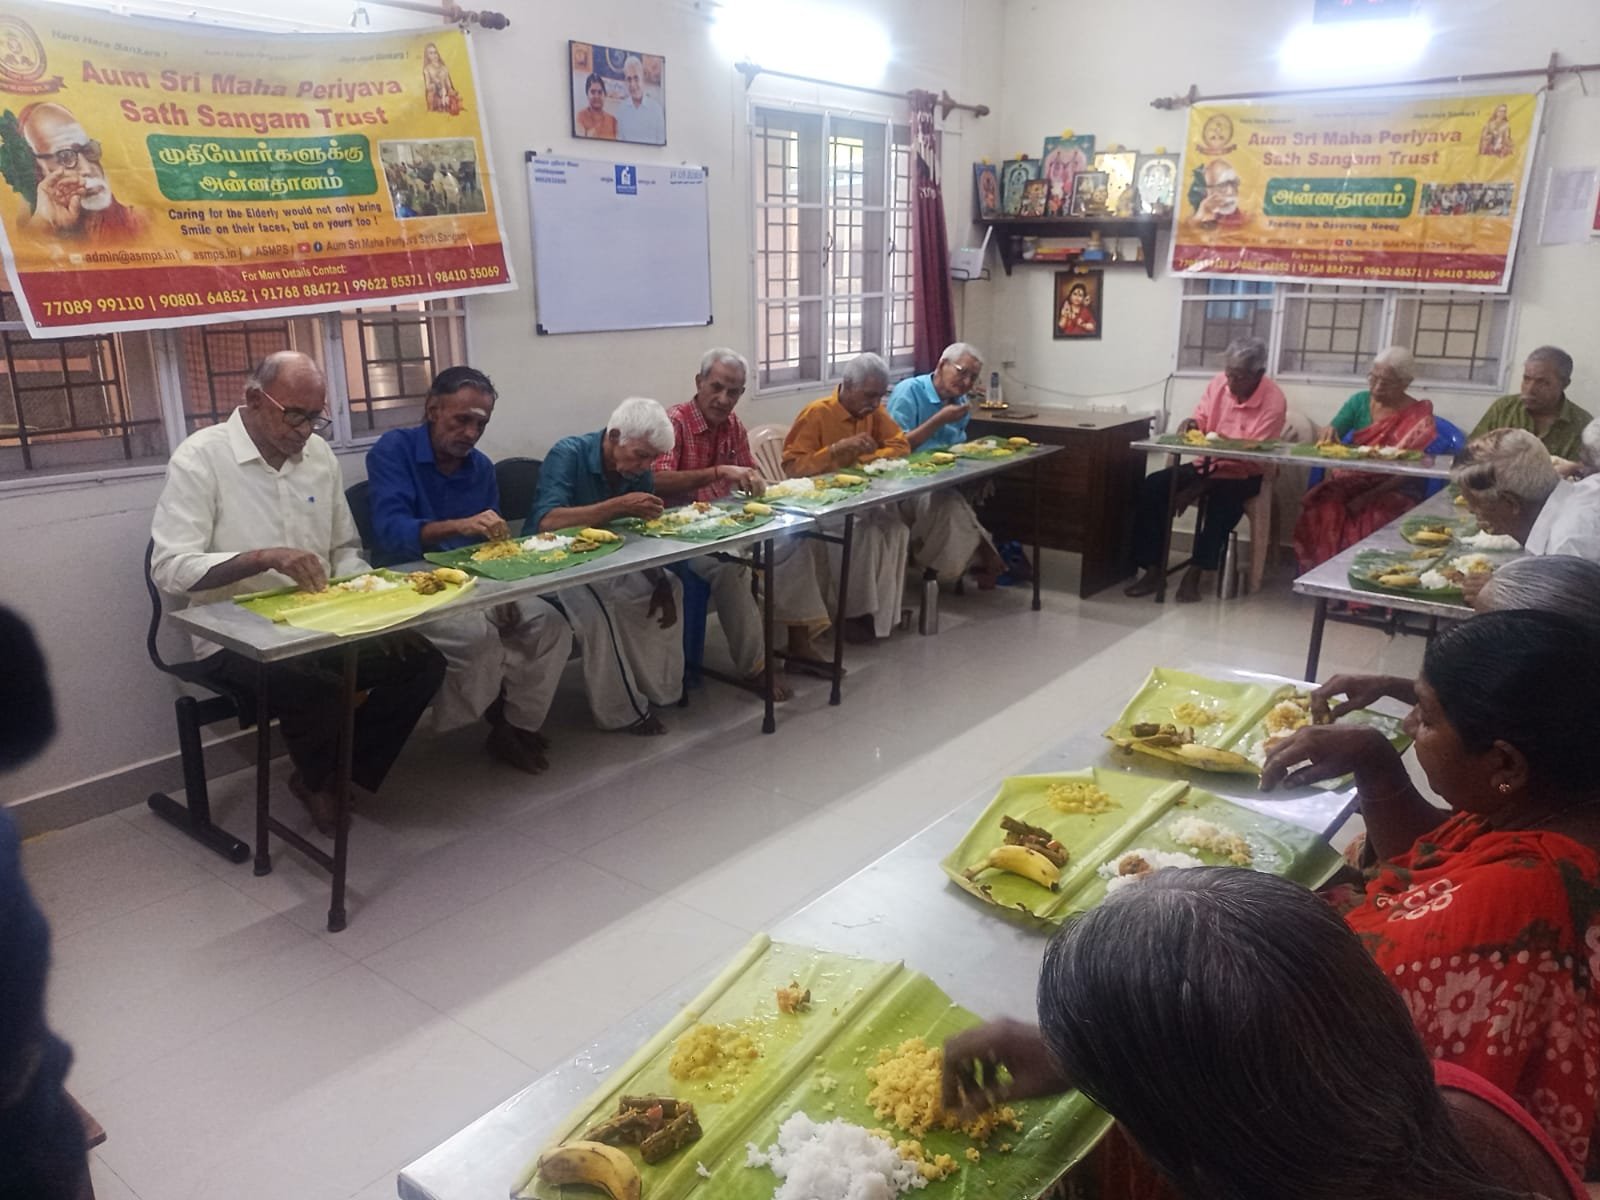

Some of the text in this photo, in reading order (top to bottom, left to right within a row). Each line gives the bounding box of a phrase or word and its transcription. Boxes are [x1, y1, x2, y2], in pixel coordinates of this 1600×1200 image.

[82, 60, 402, 103] Aum Sri Maha Periyava
[120, 99, 388, 134] Sath Sangam Trust
[1248, 129, 1462, 146] Aum Sri Maha Periyava
[159, 139, 363, 167] முதியோர்களுக்கு
[1263, 150, 1439, 169] Sath Sangam Trust
[199, 168, 343, 196] அன்னதானம்
[1272, 183, 1406, 209] அன்னதானம்
[168, 201, 382, 221] Caring for the Elderly would not only bring
[180, 223, 211, 236] Smile
[216, 225, 229, 235] on
[232, 222, 255, 234] their
[293, 219, 309, 231] but
[313, 220, 324, 230] on
[327, 218, 353, 231] yours
[356, 217, 372, 227] too
[1306, 220, 1319, 229] the
[85, 250, 176, 265] admin@asmps.in
[192, 248, 237, 262] asmps.in
[255, 244, 289, 256] ASMPS
[327, 241, 346, 251] Aum
[348, 239, 361, 250] Sri
[241, 270, 257, 282] For
[258, 267, 281, 280] More
[283, 265, 311, 279] Details
[42, 299, 92, 316] 77089
[97, 296, 144, 312] 99110
[160, 292, 203, 308] 90801
[207, 289, 247, 305] 64852
[260, 284, 300, 301] 91768
[303, 281, 341, 297] 88472
[352, 277, 388, 291] 99622
[391, 273, 423, 288] 85371
[435, 269, 467, 284] 98410
[470, 265, 500, 279] 35069
